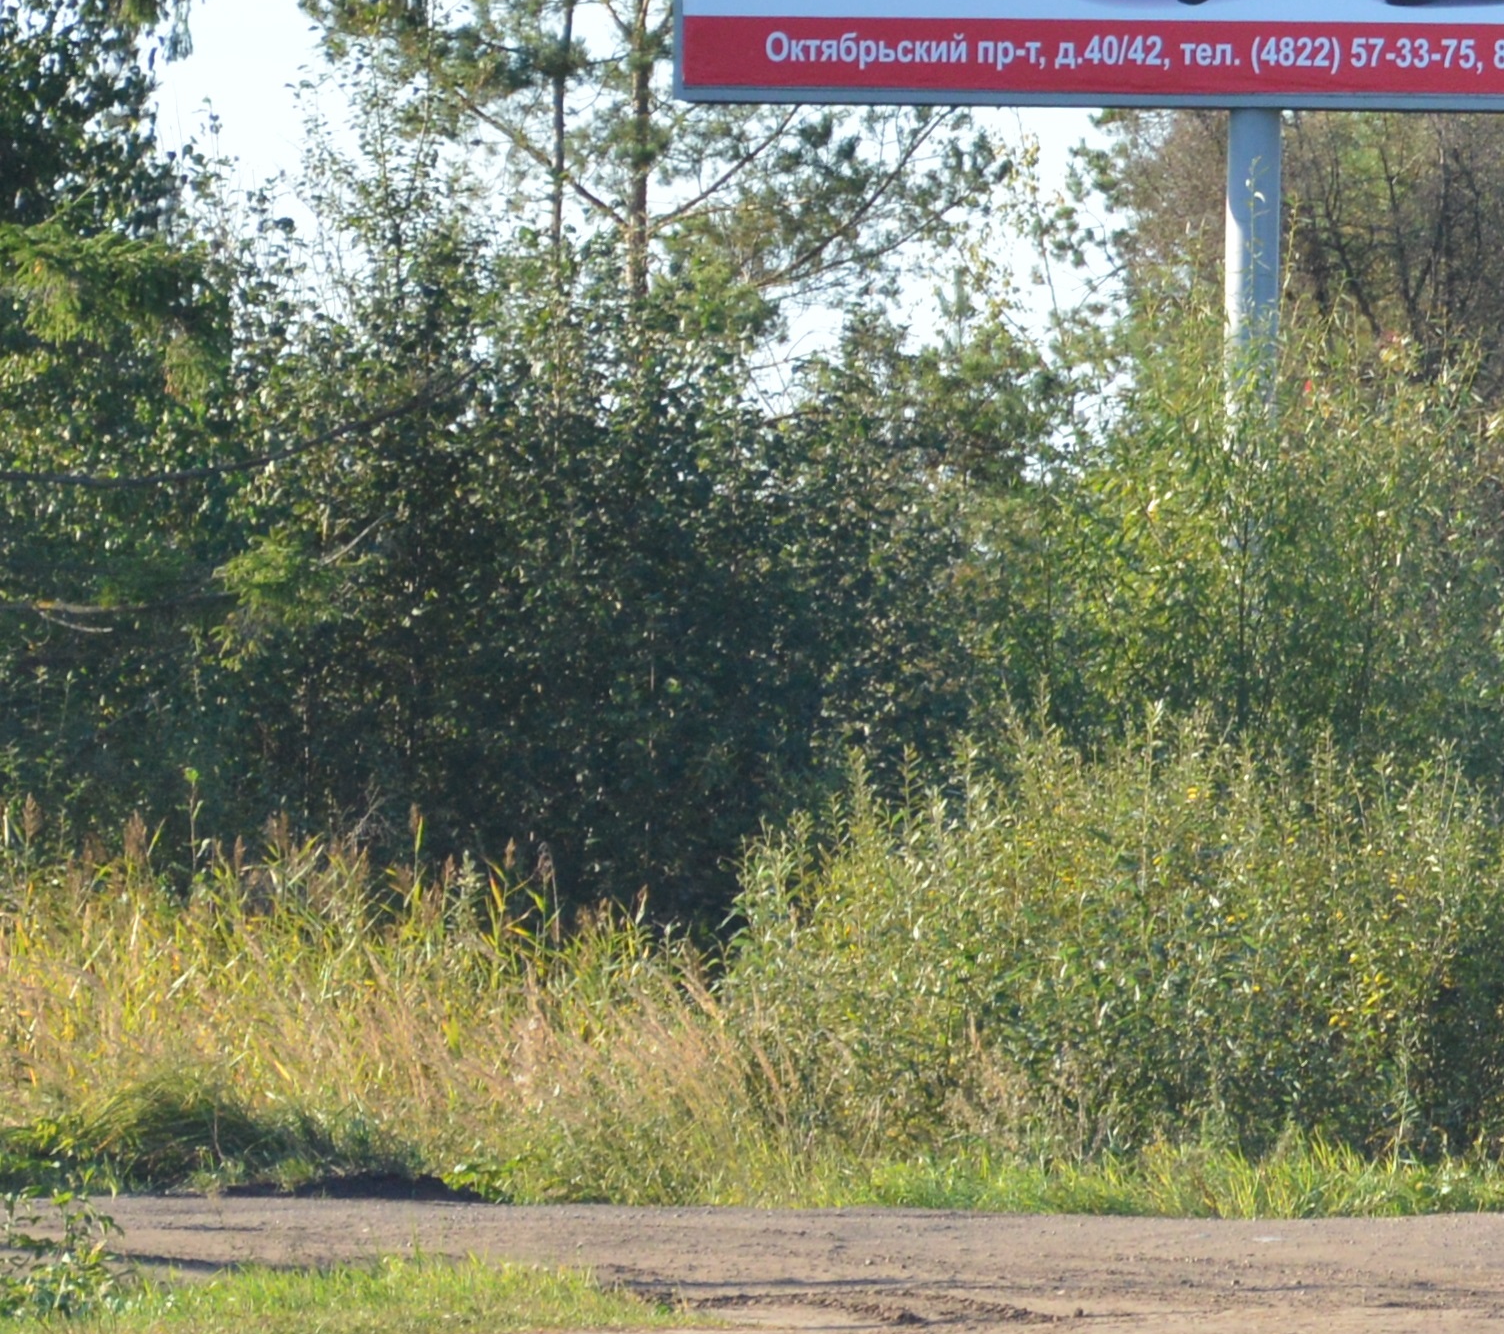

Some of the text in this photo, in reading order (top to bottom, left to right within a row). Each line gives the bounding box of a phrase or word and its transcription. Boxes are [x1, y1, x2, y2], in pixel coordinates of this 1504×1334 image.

[765, 30, 969, 70] Октябрьский
[977, 38, 1046, 71] пр-т,
[1054, 34, 1170, 70] д.40/42,
[1179, 42, 1241, 67] тел.
[1250, 36, 1341, 74] (4822)
[1350, 37, 1484, 74] 57-33-75,
